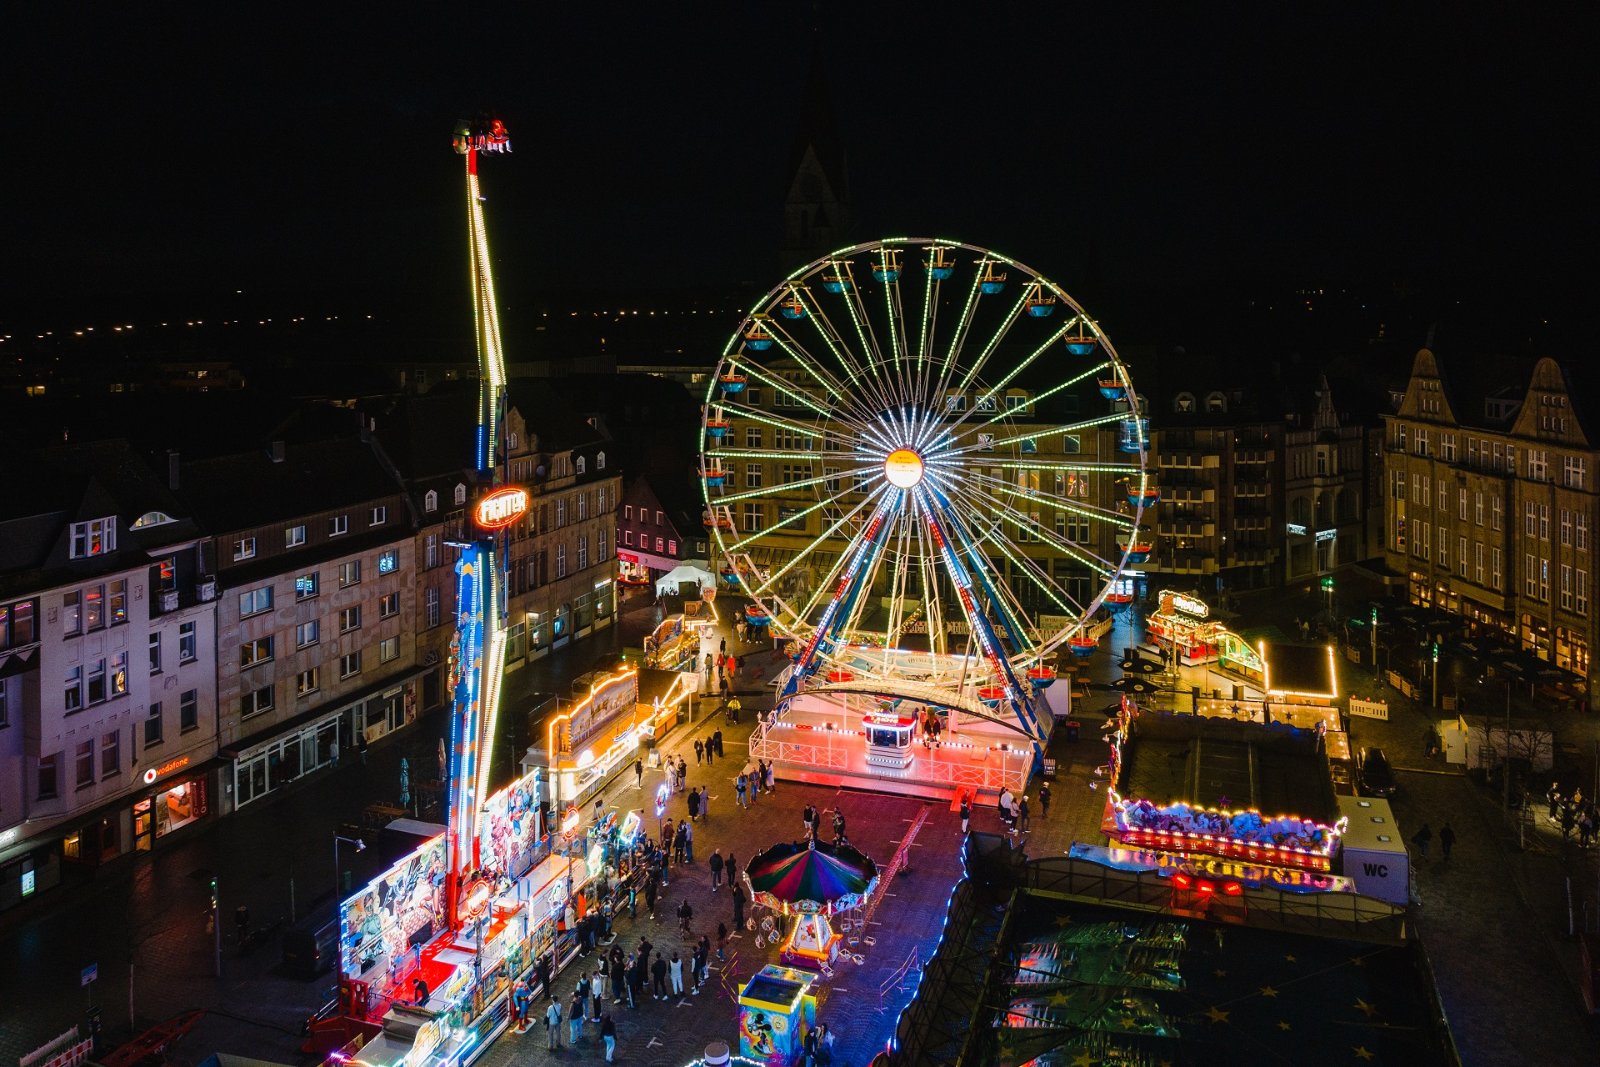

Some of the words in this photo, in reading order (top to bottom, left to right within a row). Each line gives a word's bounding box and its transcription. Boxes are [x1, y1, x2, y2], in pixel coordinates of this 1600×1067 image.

[482, 492, 526, 524] FIGHTER
[156, 757, 189, 776] vodafone
[1363, 863, 1388, 878] WC
